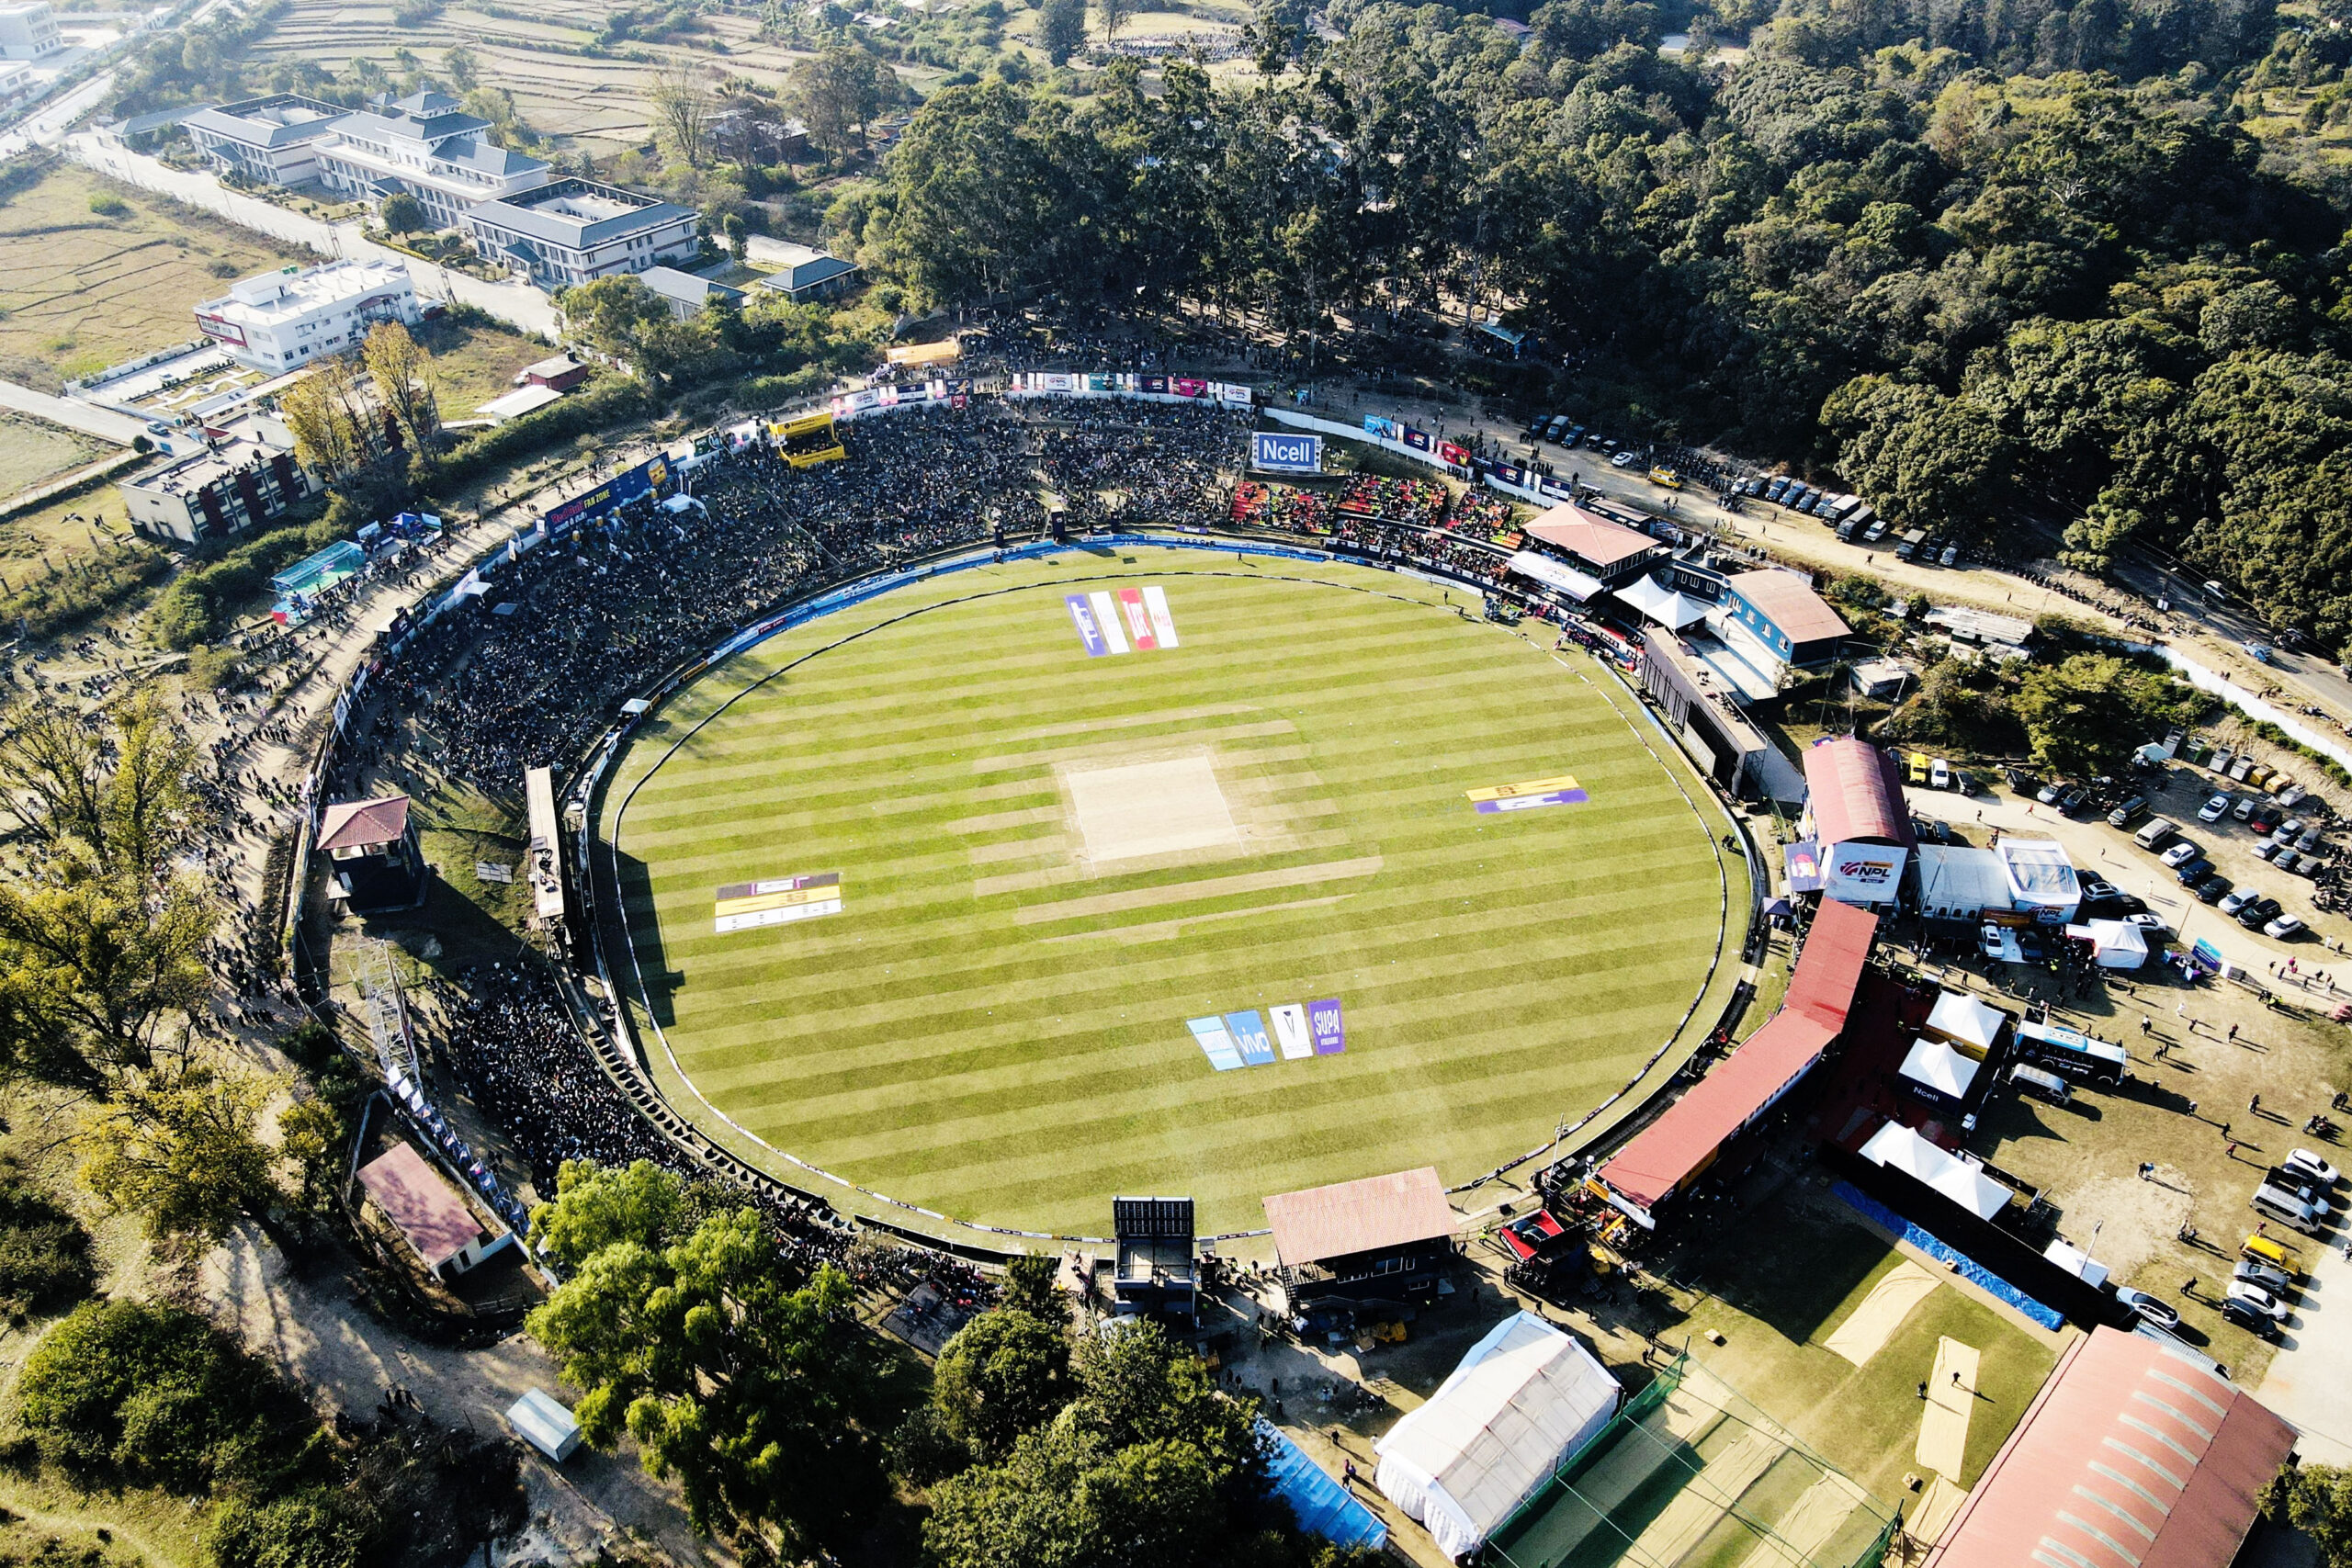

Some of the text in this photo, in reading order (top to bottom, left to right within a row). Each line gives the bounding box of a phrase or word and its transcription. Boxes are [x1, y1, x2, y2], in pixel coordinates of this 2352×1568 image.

[1263, 439, 1310, 463] Ncell
[551, 509, 568, 525] Red
[568, 499, 585, 517] Bull
[583, 496, 596, 509] FAN
[595, 489, 611, 503] ZONE
[1340, 556, 1359, 564] vivo
[791, 608, 808, 619] vivo
[1858, 867, 1892, 878] NPL
[2039, 908, 2063, 918] NPL
[1314, 1009, 1340, 1036] SUPA
[1236, 1026, 1271, 1055] vivo
[1913, 1086, 1939, 1102] Ncell
